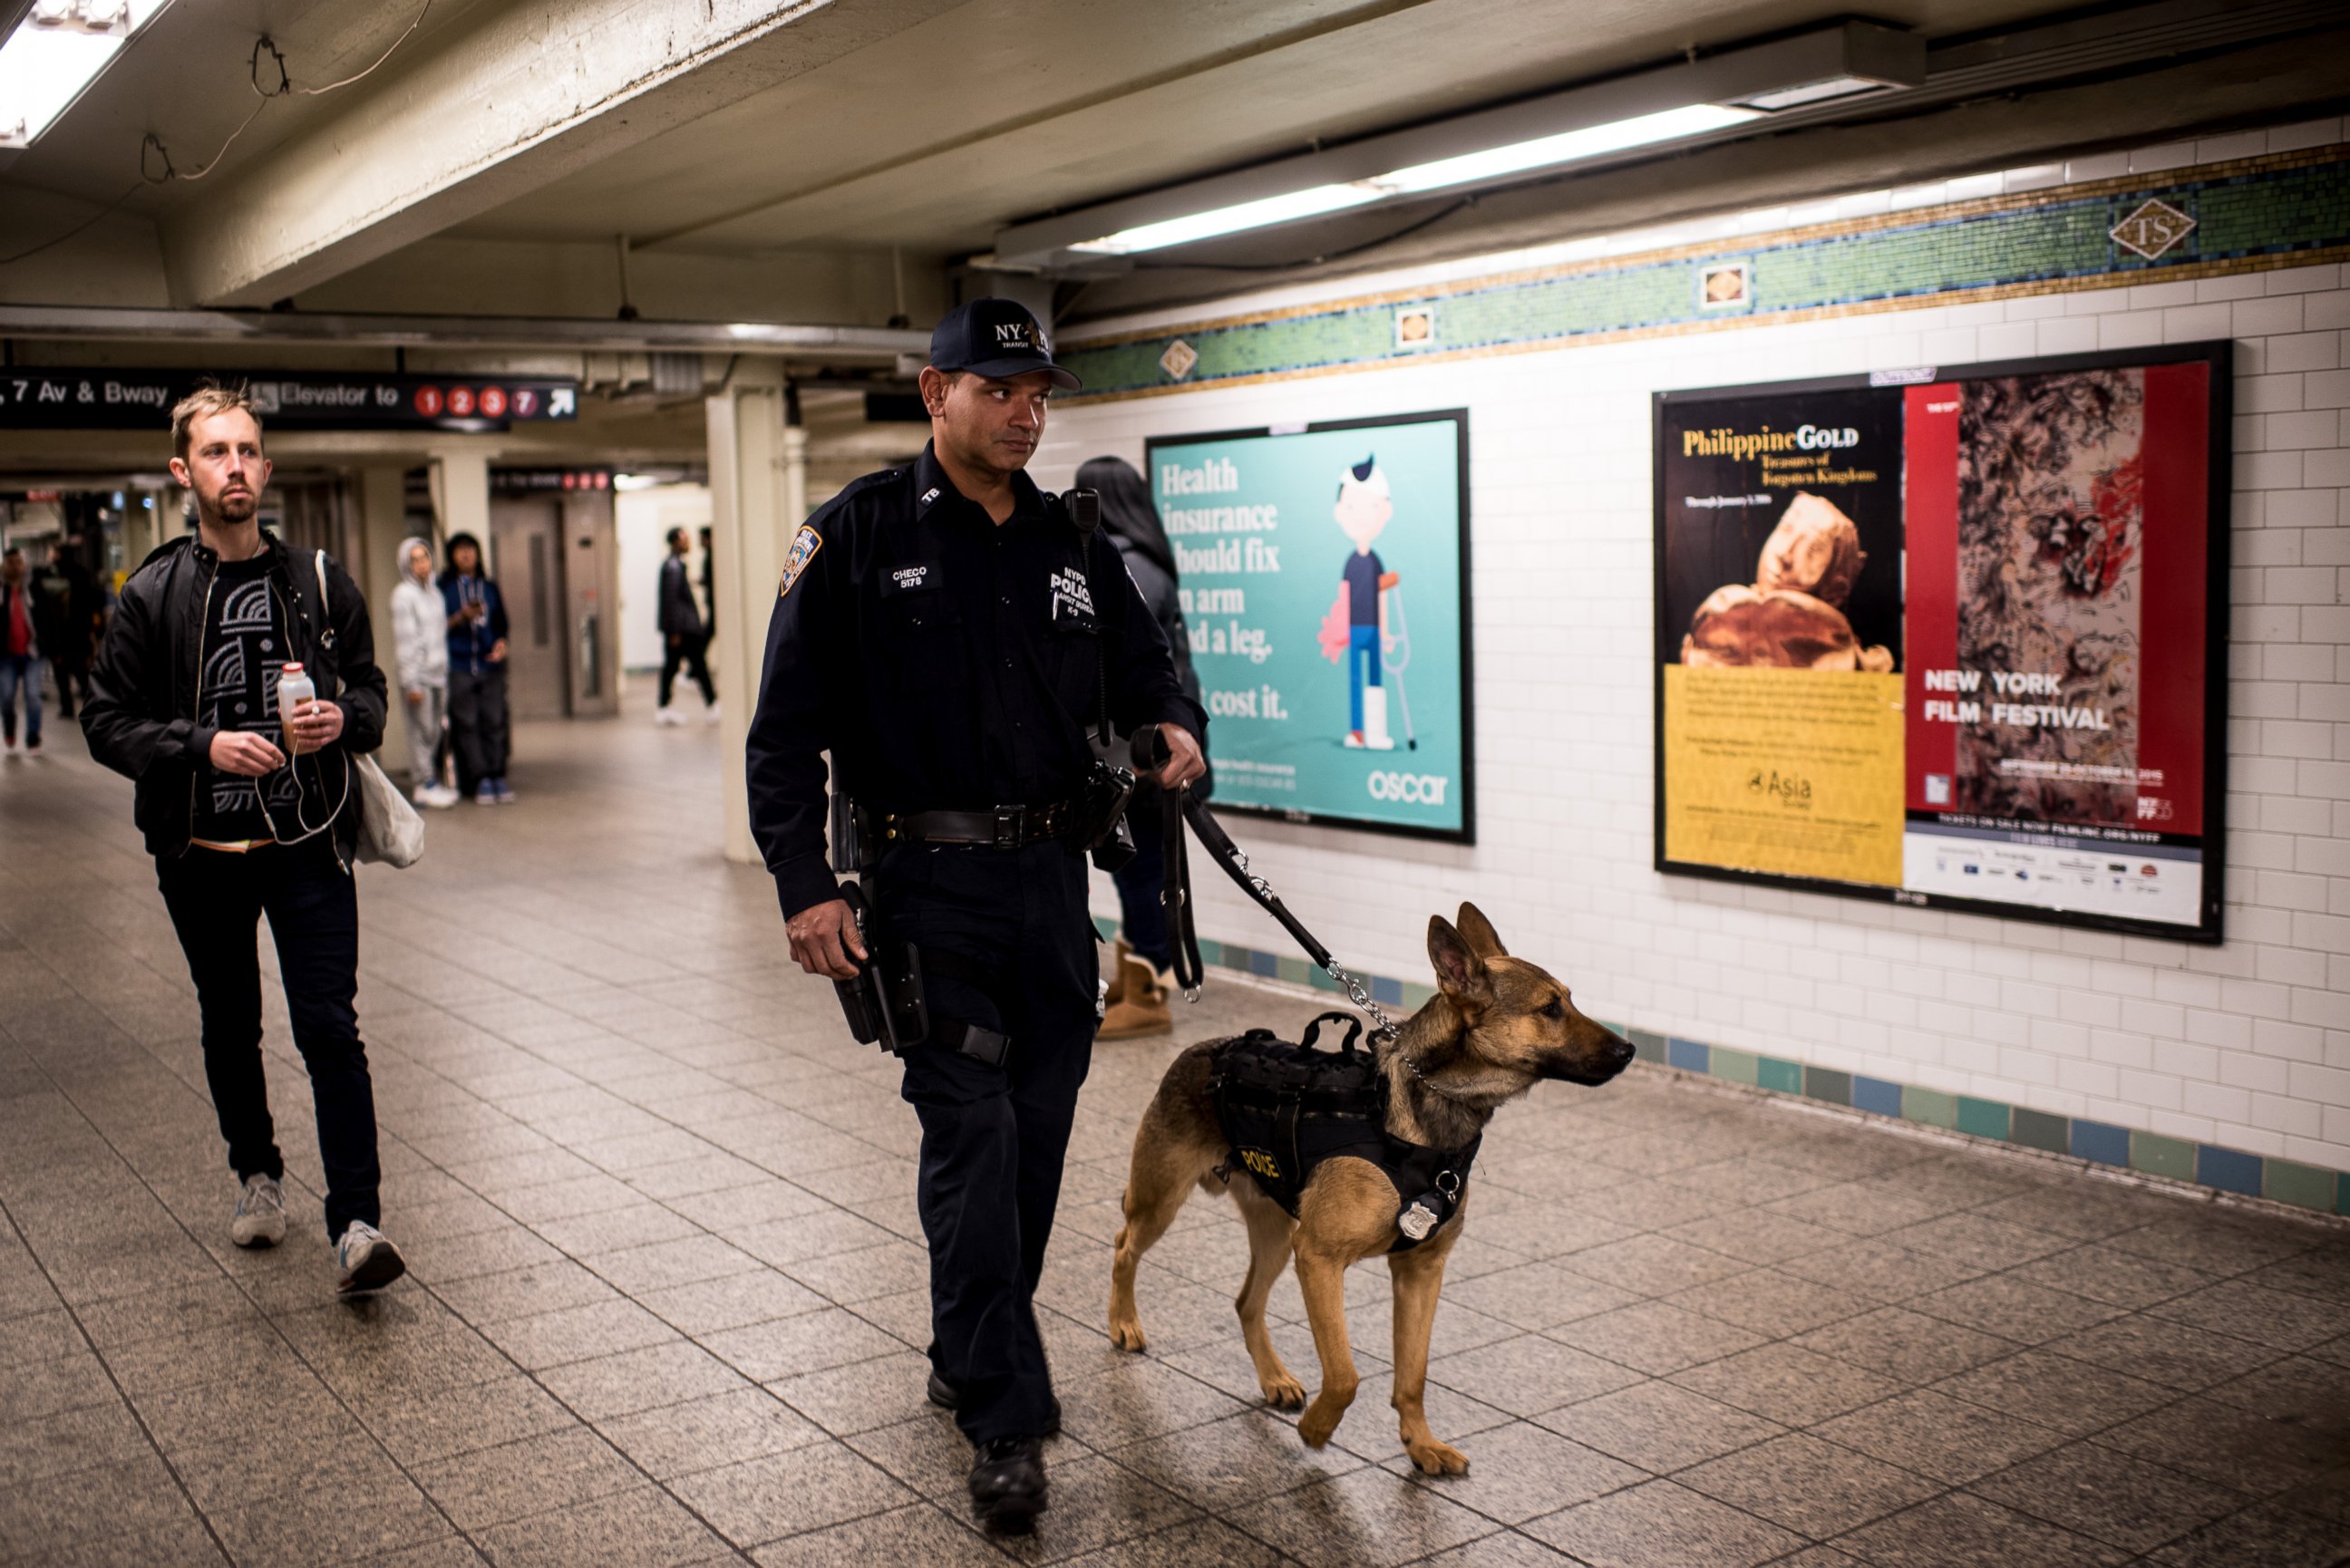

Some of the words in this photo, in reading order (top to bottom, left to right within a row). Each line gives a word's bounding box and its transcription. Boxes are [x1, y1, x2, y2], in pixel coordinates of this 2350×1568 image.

[12, 380, 29, 402] 7
[38, 381, 67, 402] Av
[77, 381, 94, 403] &
[104, 382, 169, 407] Bway
[280, 382, 367, 406] Elevator
[375, 384, 400, 406] to
[454, 391, 470, 413] 2
[485, 392, 501, 413] 3
[517, 391, 531, 414] 7
[1161, 457, 1238, 496] Health
[1163, 502, 1278, 535] insurance
[1174, 537, 1240, 574] hould
[1245, 537, 1281, 573] fix
[892, 566, 927, 581] CHECO
[900, 576, 922, 588] 5178
[1064, 566, 1086, 586] NYPD
[1178, 587, 1194, 614] n
[1197, 587, 1246, 614] arm
[1211, 627, 1227, 653] a
[1229, 619, 1273, 664] leg.
[1925, 670, 1981, 692] NEW
[1992, 672, 2063, 695] YORK
[1210, 689, 1258, 717] cost
[1261, 683, 1288, 720] it.
[1925, 700, 1981, 723] FILM
[1992, 703, 2111, 731] FESTIVAL
[1367, 770, 1449, 805] oscar
[1767, 771, 1811, 799] Asia
